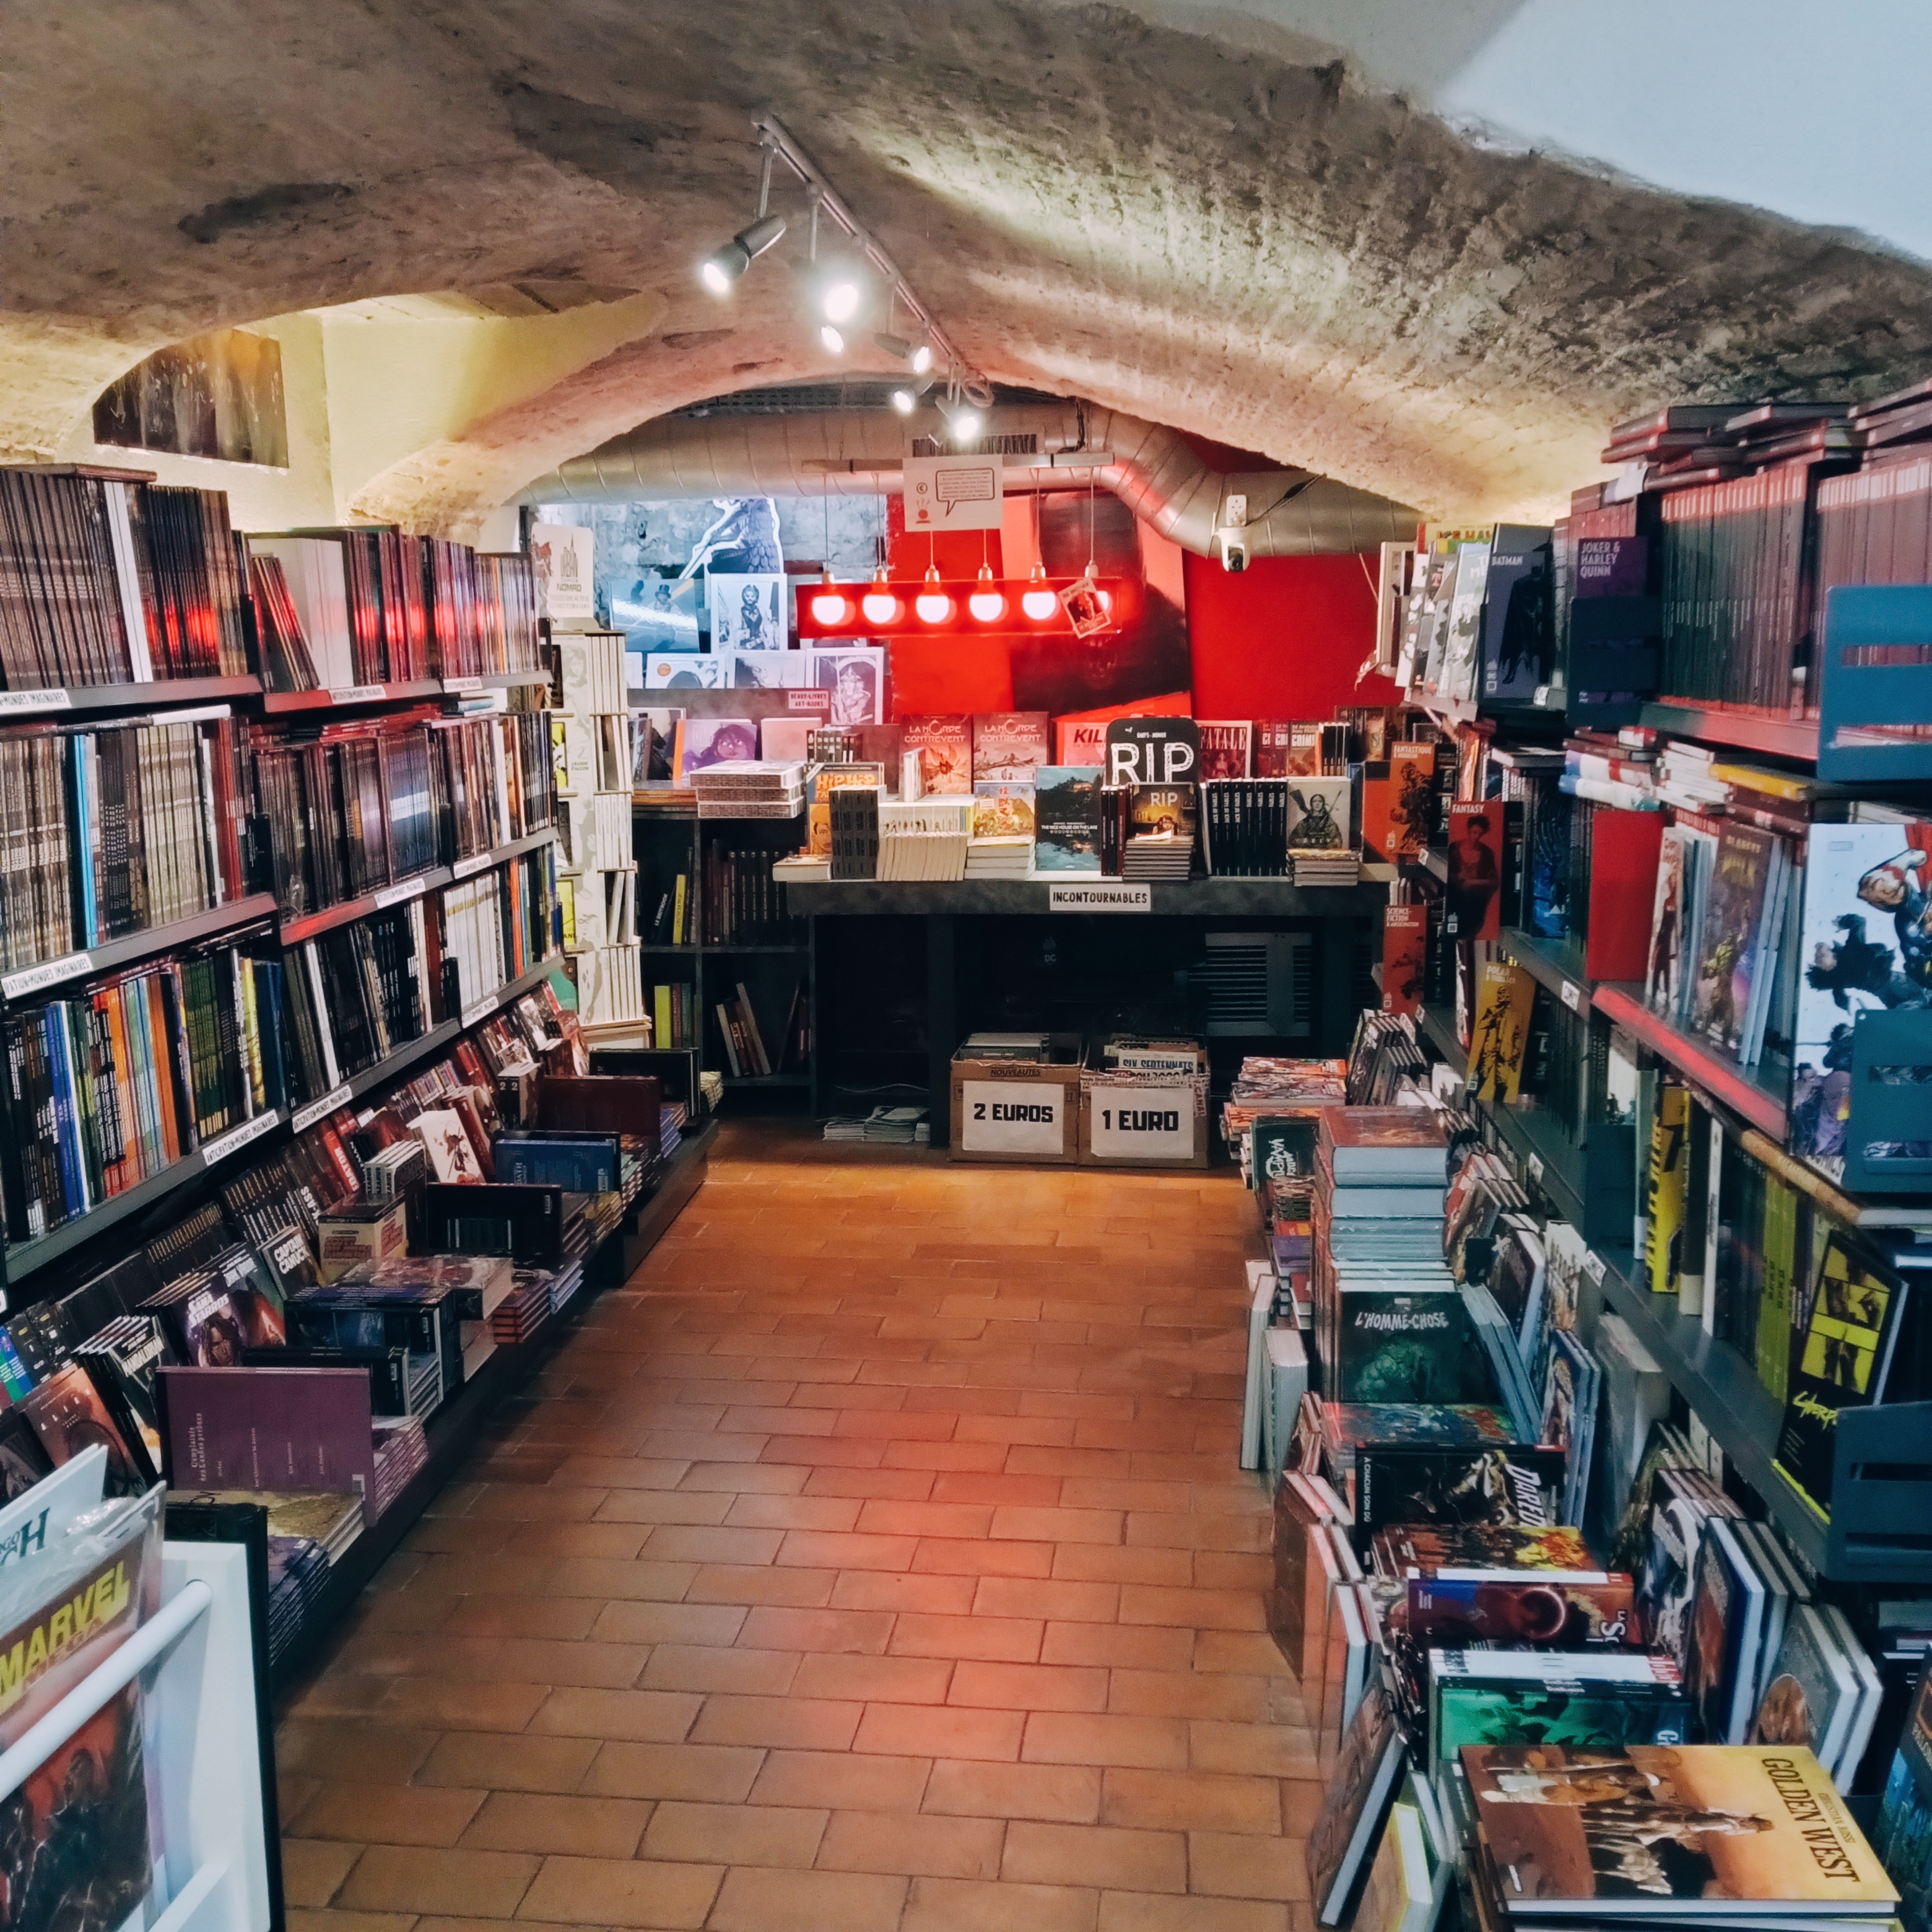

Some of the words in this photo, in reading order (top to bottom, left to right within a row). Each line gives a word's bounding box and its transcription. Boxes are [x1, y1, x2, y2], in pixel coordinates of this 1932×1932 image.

[1582, 541, 1611, 554] JOKER
[1613, 541, 1621, 553] &
[1492, 555, 1523, 566] BATMAN
[1580, 553, 1617, 566] HARLEY
[1580, 565, 1611, 580] QUINN
[985, 724, 998, 733] LA
[1074, 728, 1107, 744] KIL
[904, 735, 966, 743] CONTREVENT
[980, 734, 1042, 742] CONTREVENT
[1201, 728, 1247, 751] FATALE
[1393, 745, 1432, 754] FANTASTIQUE
[1111, 742, 1194, 785] RIP
[1150, 792, 1178, 807] RIP
[1452, 804, 1485, 814] FANTASY
[1053, 891, 1147, 904] INCONTOURNABLES
[54, 957, 90, 977] IMAGINAIRES
[1123, 1059, 1138, 1067] SIX
[499, 1081, 507, 1090] 2
[511, 1082, 518, 1090] 2
[973, 1103, 986, 1120] 2
[992, 1103, 1053, 1123] EUROS
[1102, 1110, 1111, 1130] 1
[1118, 1110, 1178, 1131] EURO
[274, 1233, 304, 1262] CAPTAIN
[279, 1245, 310, 1274] CANUCK
[188, 1292, 214, 1313] SANA
[188, 1293, 230, 1328] STARROS
[1355, 1312, 1450, 1331] L'HOMME-CHOSE
[121, 1335, 165, 1378] MANDALORIAN
[1617, 1611, 1625, 1621] LA
[0, 1559, 131, 1698] MARVEL
[1761, 1757, 1827, 1823] GOLDEN
[1801, 1827, 1861, 1883] WEST
